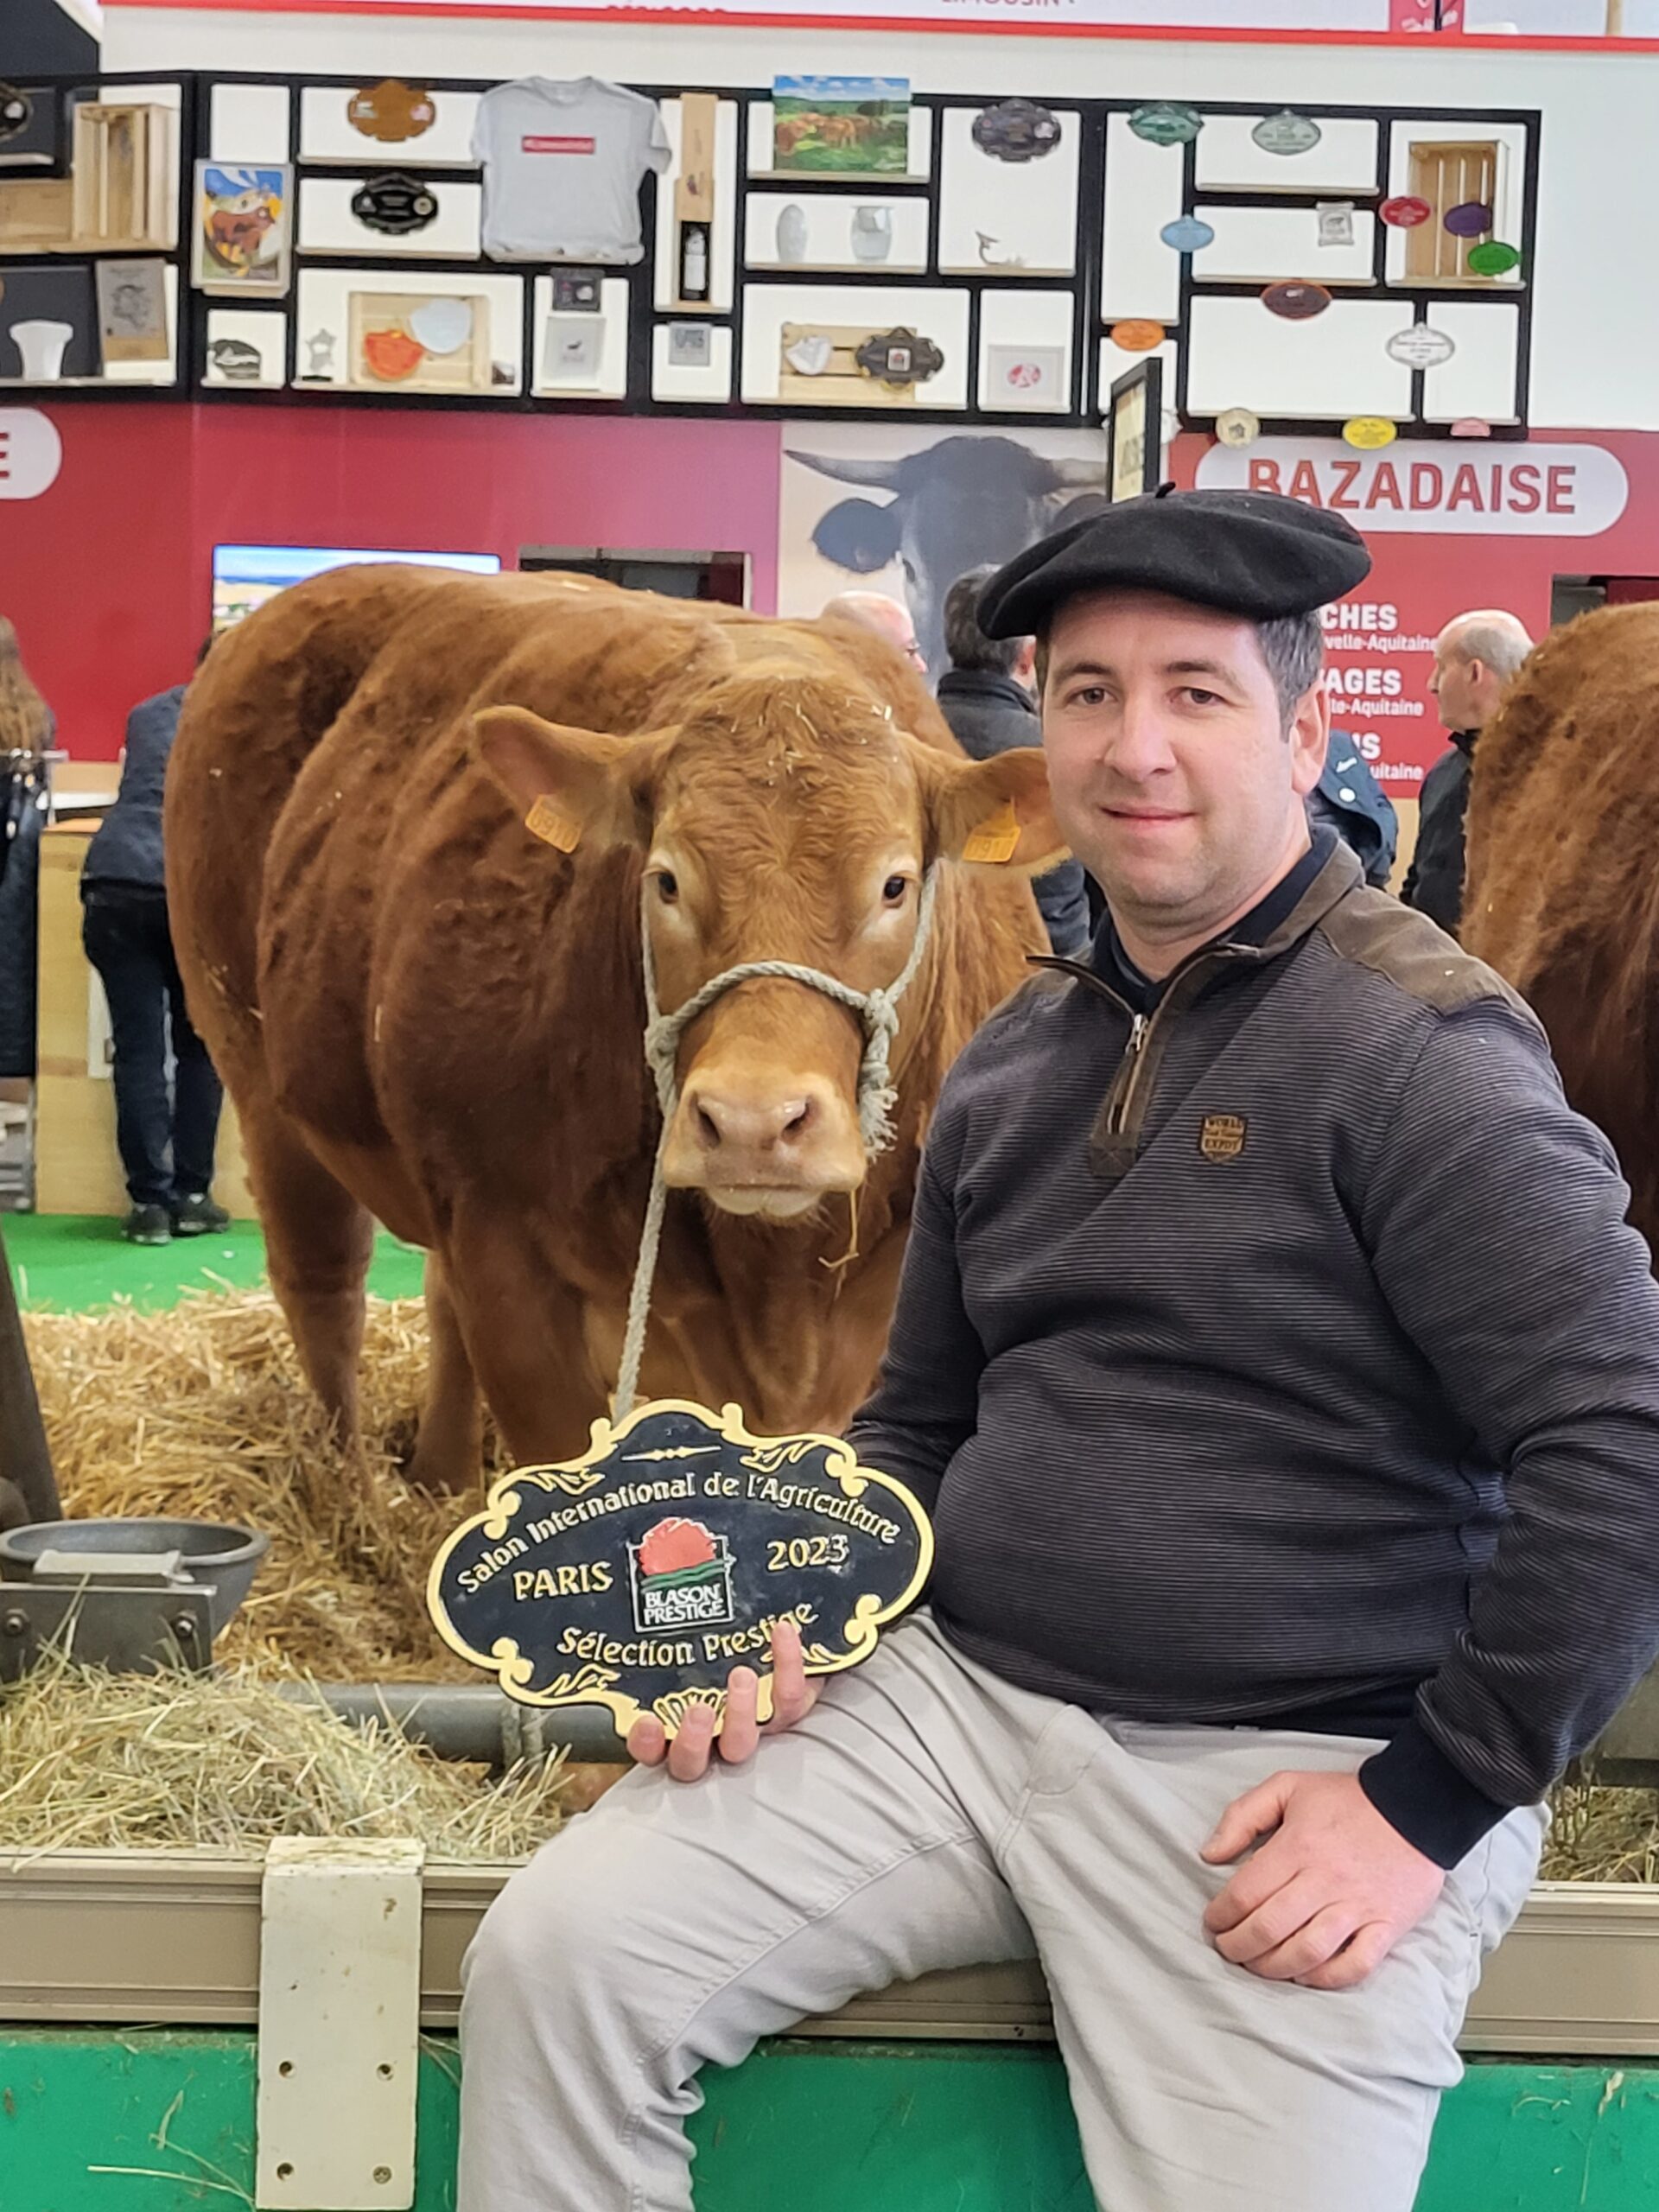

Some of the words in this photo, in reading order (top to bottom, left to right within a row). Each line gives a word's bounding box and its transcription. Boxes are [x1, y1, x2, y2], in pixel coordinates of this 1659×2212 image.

[1248, 458, 1576, 514] BAZADAISE
[1320, 667, 1402, 696] AGES
[456, 1535, 530, 1594] Salon
[525, 1471, 696, 1544] International
[703, 1471, 741, 1497] de
[747, 1473, 901, 1545] l'Agriculture
[512, 1560, 613, 1601] PARIS
[766, 1533, 850, 1573] 2023
[643, 1599, 727, 1625] PRESTIGE
[645, 1583, 721, 1608] BLASON
[556, 1626, 696, 1668] Sélection
